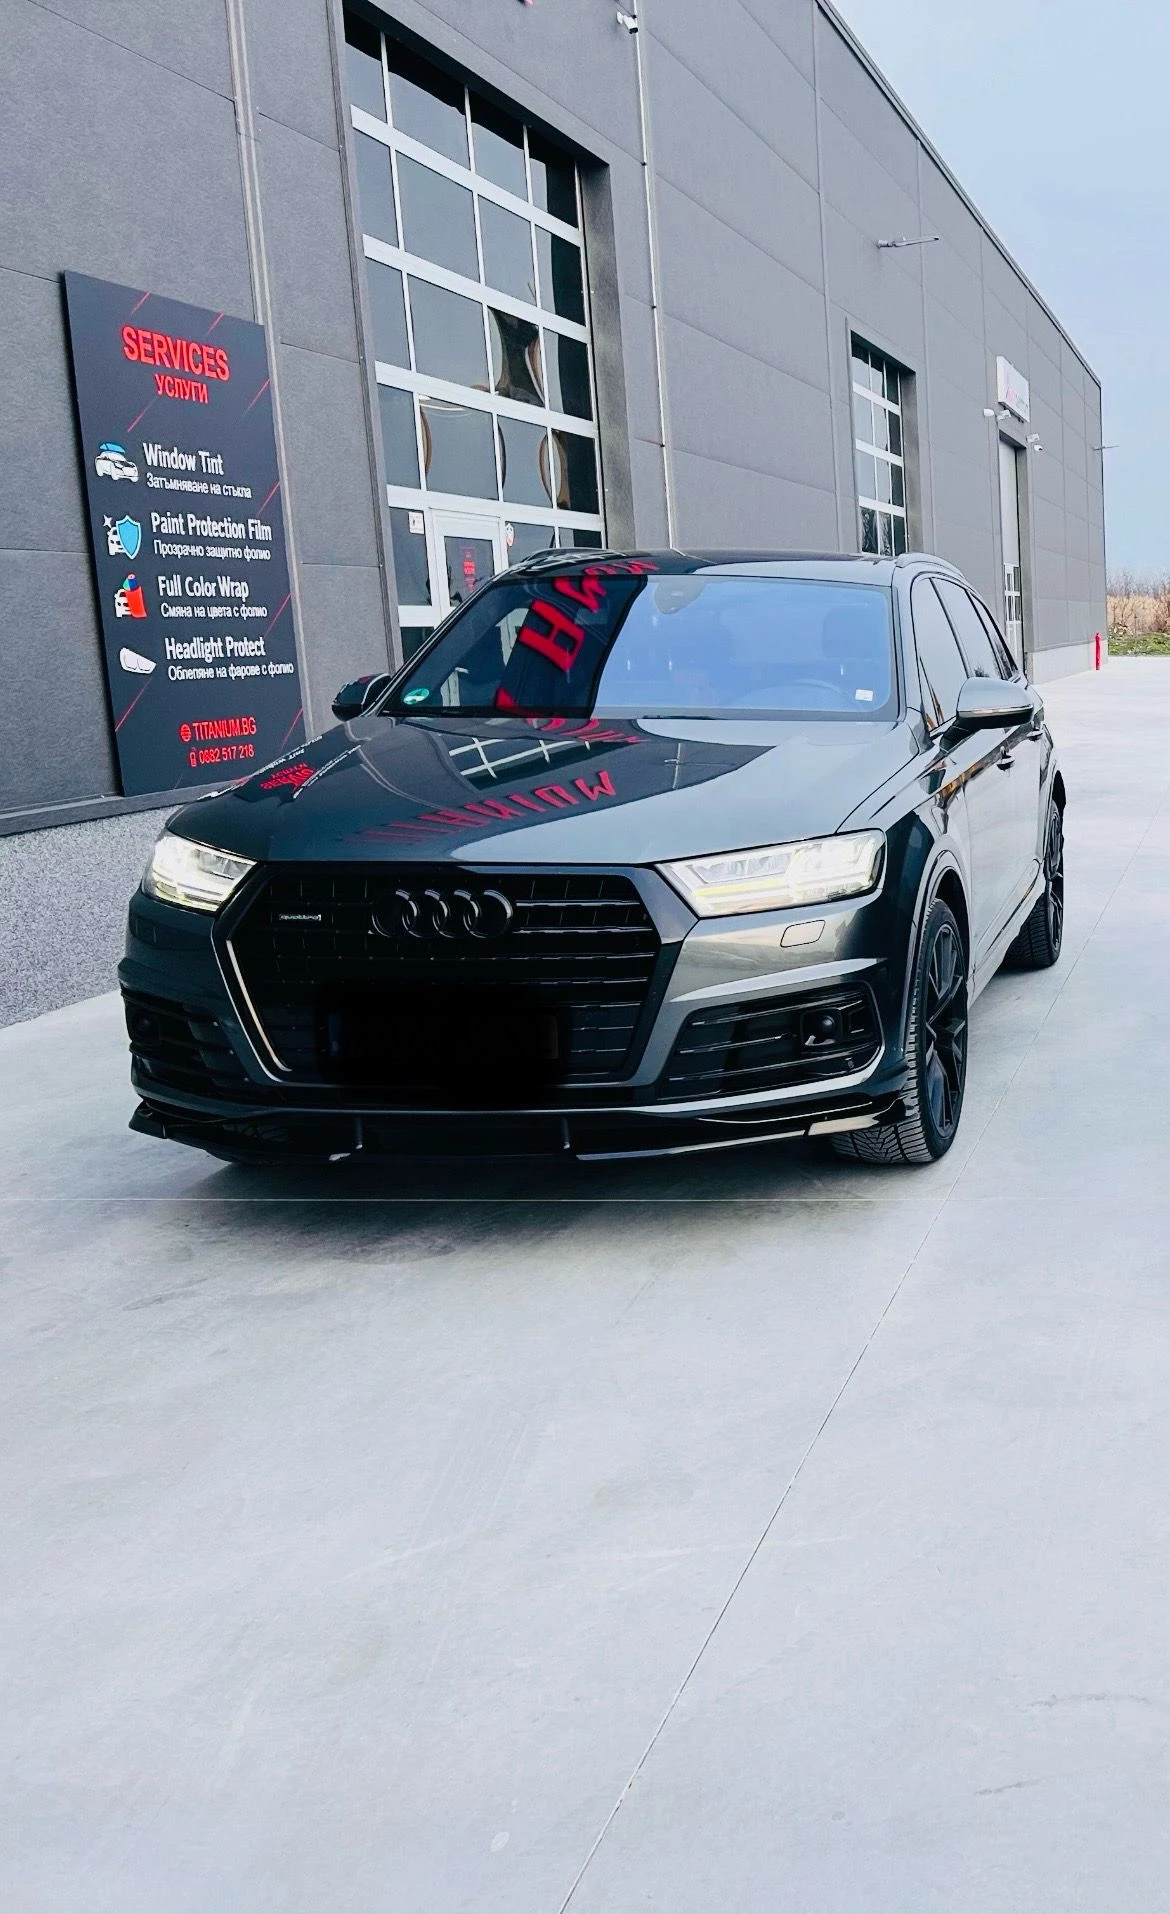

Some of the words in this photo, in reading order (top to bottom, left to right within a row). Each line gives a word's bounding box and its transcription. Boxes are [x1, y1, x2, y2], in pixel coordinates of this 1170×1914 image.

[122, 326, 230, 381] SERVICES
[154, 373, 209, 404] УСЛУГИ
[142, 442, 196, 472] Window
[198, 450, 224, 475] Tint
[146, 472, 209, 494] Затъмняване
[209, 483, 221, 495] на
[222, 485, 252, 499] стъкла
[150, 512, 186, 536] Paint
[186, 513, 246, 539] Protection
[247, 518, 273, 541] Film
[153, 539, 205, 559] Прозрачно
[205, 545, 243, 560] защитно
[243, 545, 271, 562] фолио
[157, 574, 182, 597] Full
[184, 575, 217, 598] Color
[217, 575, 249, 602] Wrap
[160, 602, 192, 618] Смяна
[194, 606, 206, 618] на
[207, 606, 232, 619] цвета
[233, 607, 239, 617] с
[240, 604, 268, 620] фолио
[164, 637, 224, 663] Headlight
[225, 636, 266, 658] Protect
[167, 665, 214, 681] Облепяне
[216, 667, 227, 679] на
[228, 664, 260, 680] фарове
[261, 666, 268, 675] с
[268, 662, 294, 678] фолио
[192, 717, 257, 740] TITANIUM.BG
[222, 745, 238, 761] 517
[239, 743, 255, 758] 218
